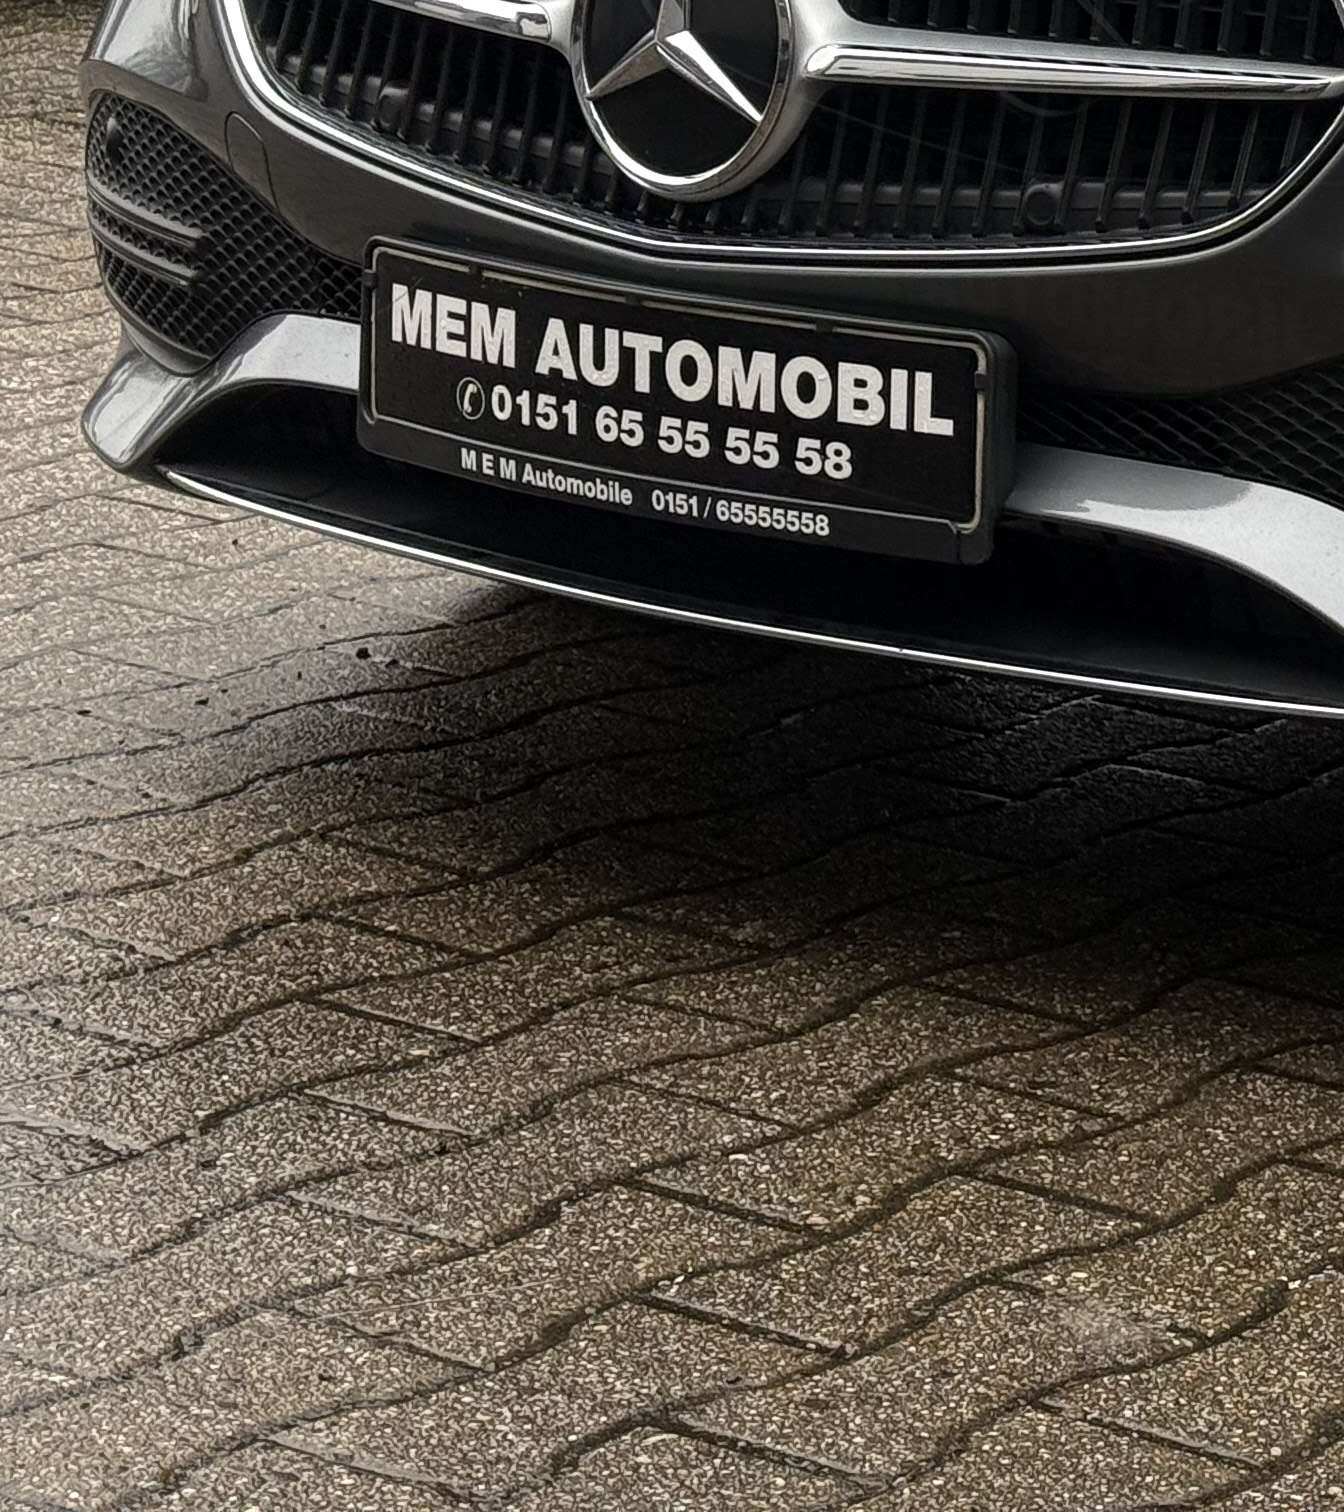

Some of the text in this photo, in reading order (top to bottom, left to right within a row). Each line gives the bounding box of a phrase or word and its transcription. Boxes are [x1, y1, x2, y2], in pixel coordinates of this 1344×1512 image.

[391, 283, 954, 436] MEM AUTOMOBIL
[491, 384, 853, 480] 0151 65 55 55 58
[522, 462, 633, 506] Automobile
[716, 499, 830, 537] 65555558
